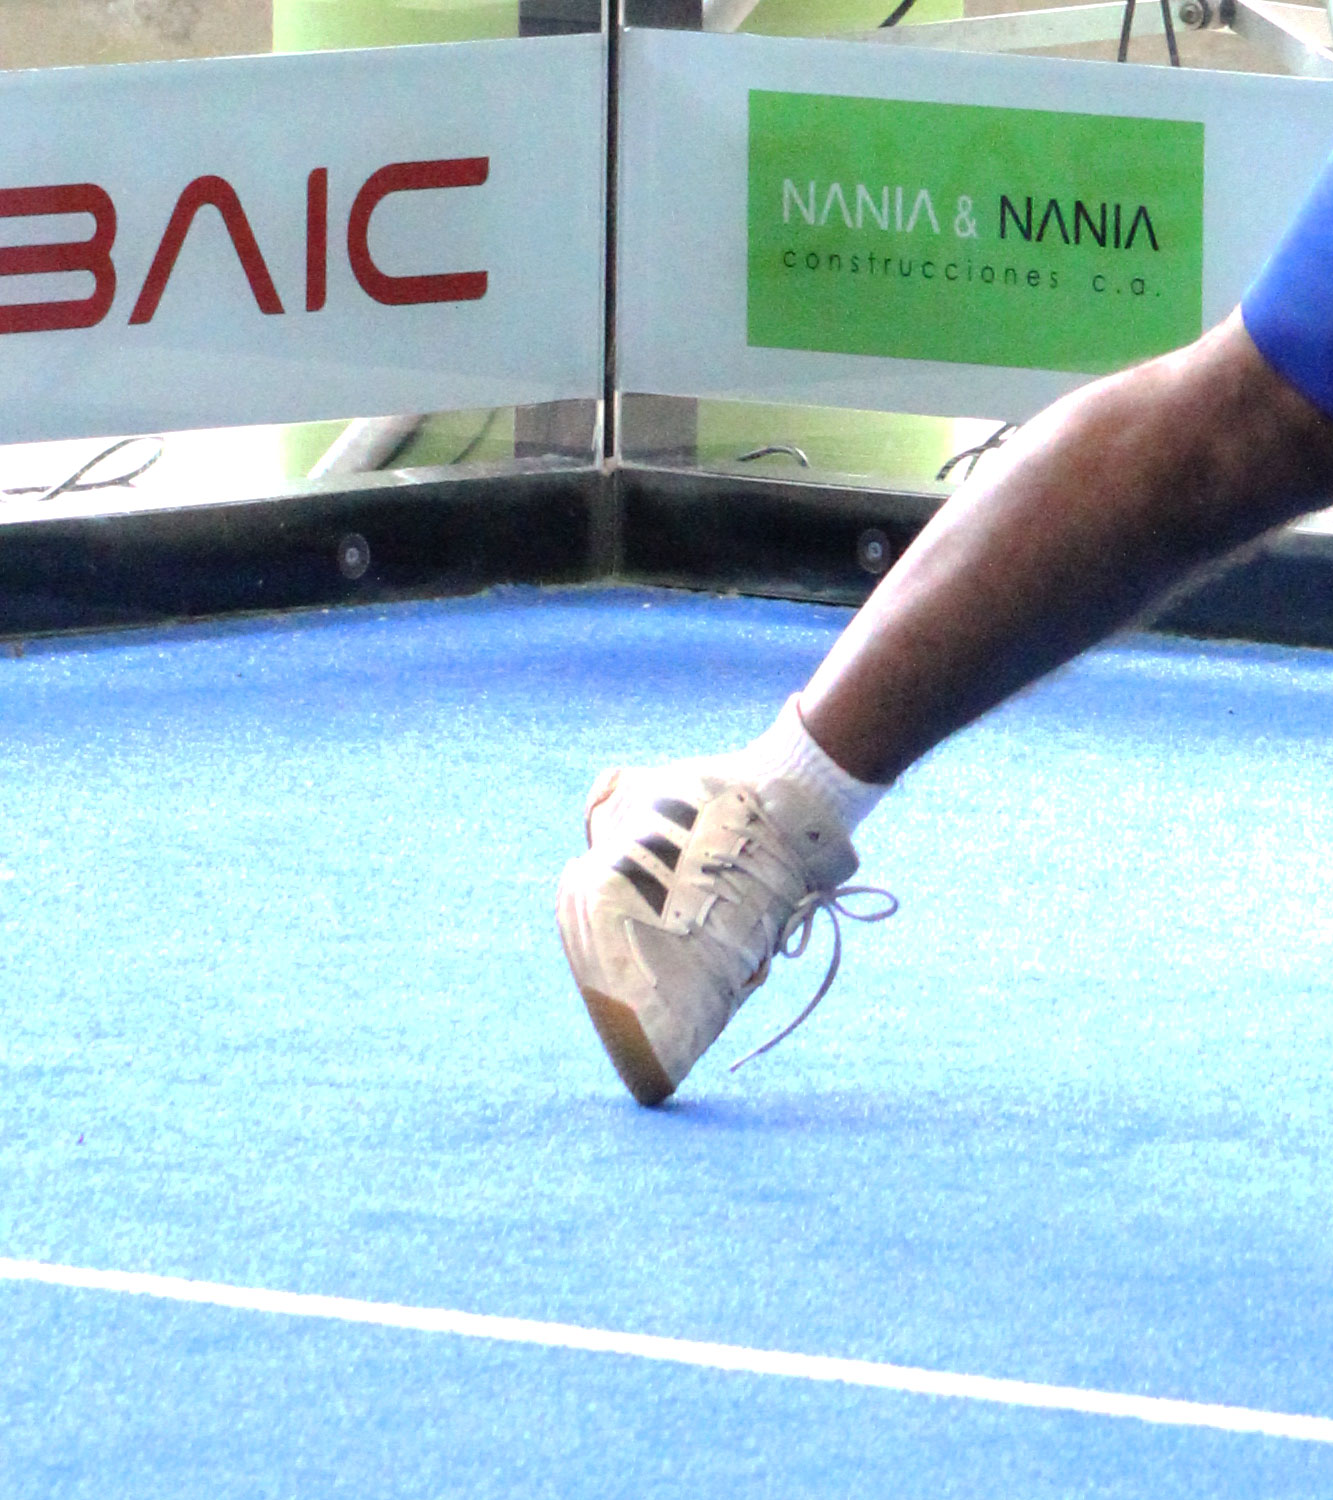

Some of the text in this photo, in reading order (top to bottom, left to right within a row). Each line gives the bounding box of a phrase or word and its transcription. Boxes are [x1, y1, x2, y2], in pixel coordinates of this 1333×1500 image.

[0, 156, 490, 335] BAIC
[781, 178, 1160, 252] NANIA & NANIA
[782, 249, 1162, 298] construcciones c.a.
